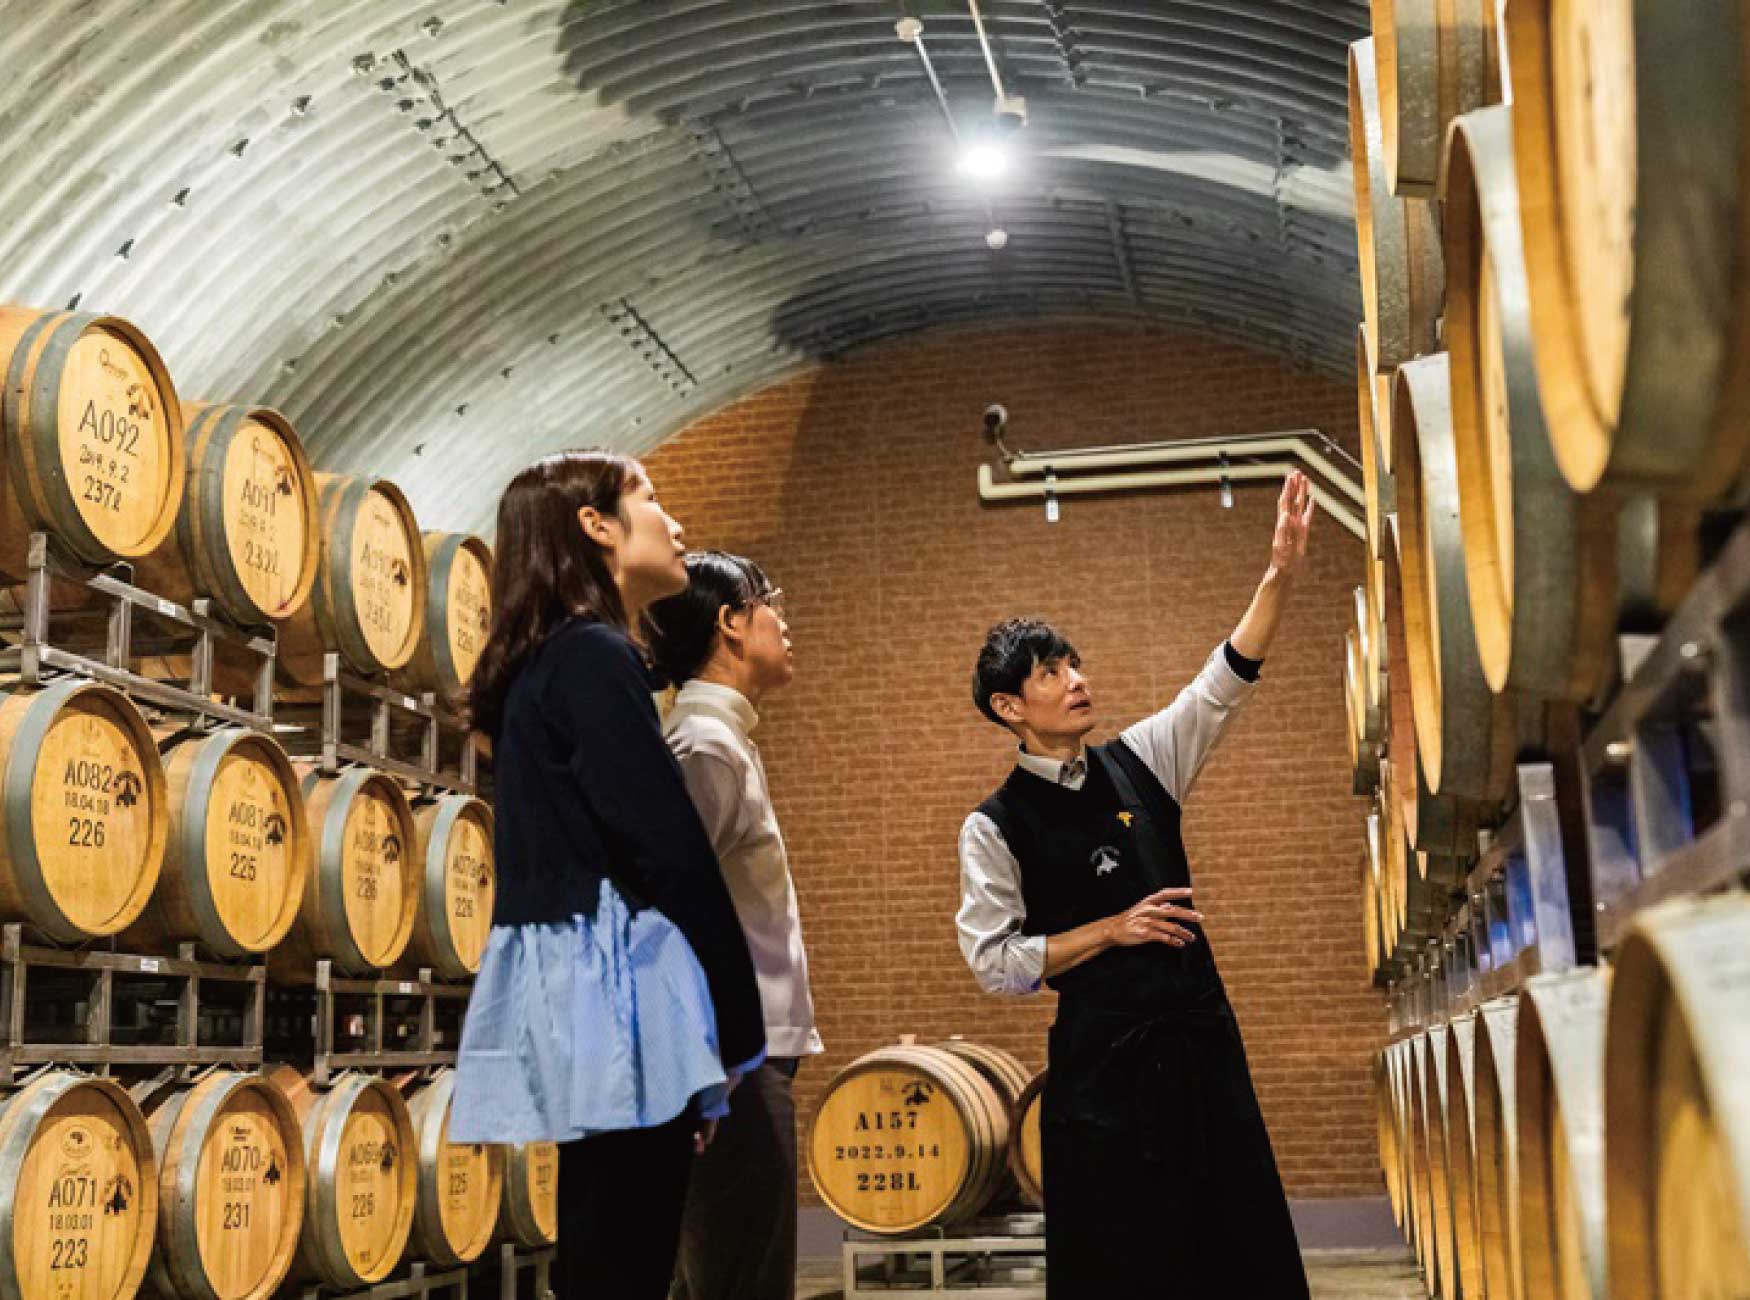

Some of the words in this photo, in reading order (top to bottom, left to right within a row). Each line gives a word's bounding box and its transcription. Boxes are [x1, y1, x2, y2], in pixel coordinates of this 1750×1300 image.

[77, 399, 141, 457] A092
[64, 757, 113, 794] A082
[69, 816, 105, 849] 226
[231, 851, 257, 881] 225
[855, 1111, 918, 1131] A157
[221, 1145, 260, 1173] A070
[835, 1144, 939, 1160] 2022.9.14
[48, 1177, 97, 1208] A071
[857, 1171, 921, 1191] 228L
[223, 1201, 249, 1230] 231
[50, 1238, 88, 1269] 223
